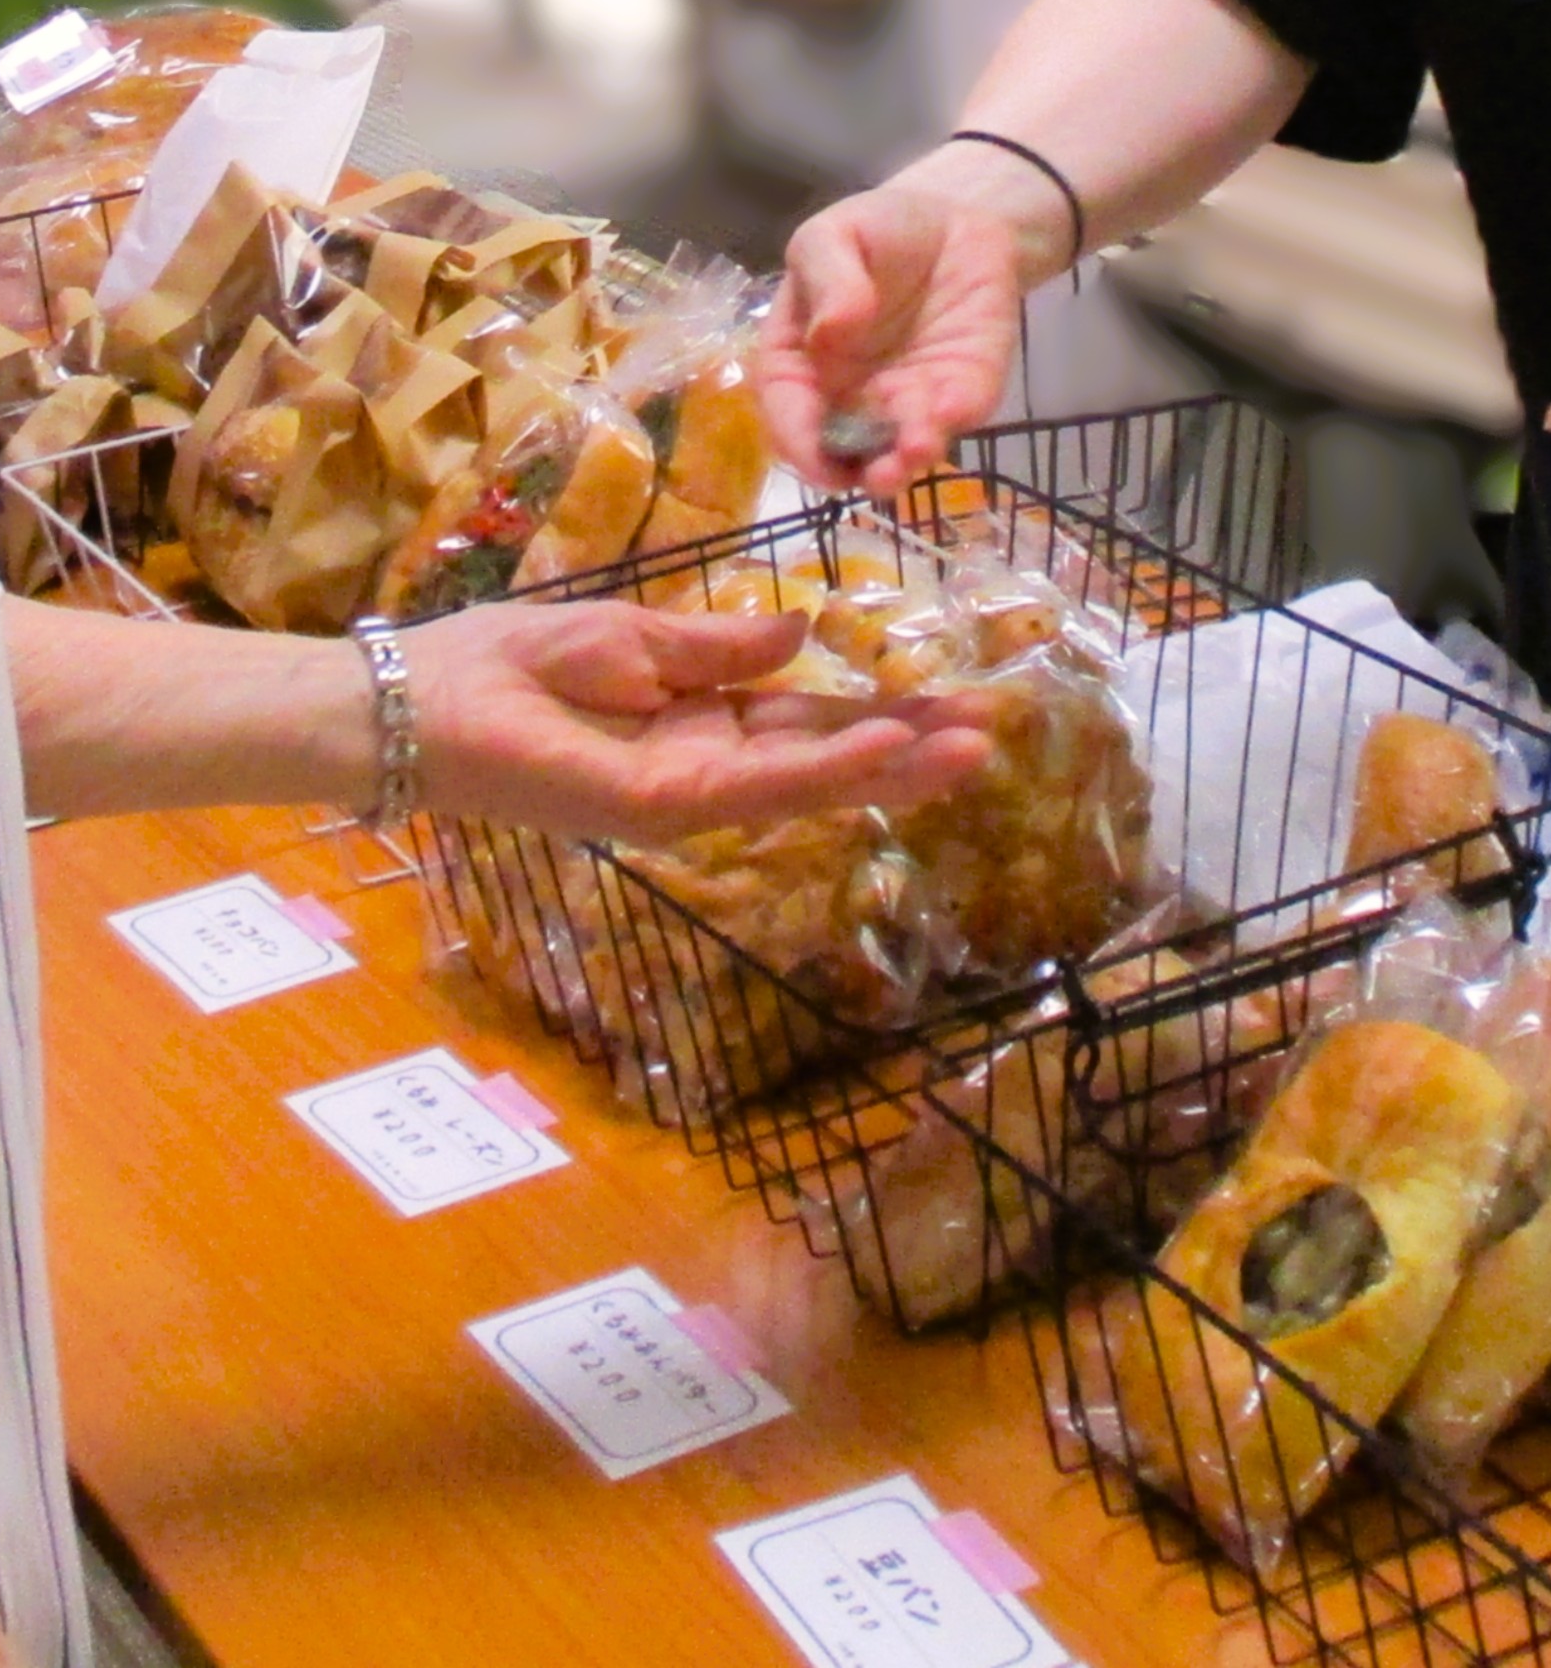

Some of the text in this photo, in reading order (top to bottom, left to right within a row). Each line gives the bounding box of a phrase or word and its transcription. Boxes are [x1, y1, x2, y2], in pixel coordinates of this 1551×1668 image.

[372, 1108, 437, 1158] ¥200
[396, 1075, 503, 1166] くるみ レーズン
[567, 1340, 643, 1403] ¥200
[823, 1574, 881, 1631] ¥200
[858, 1548, 941, 1627] 豆パン
